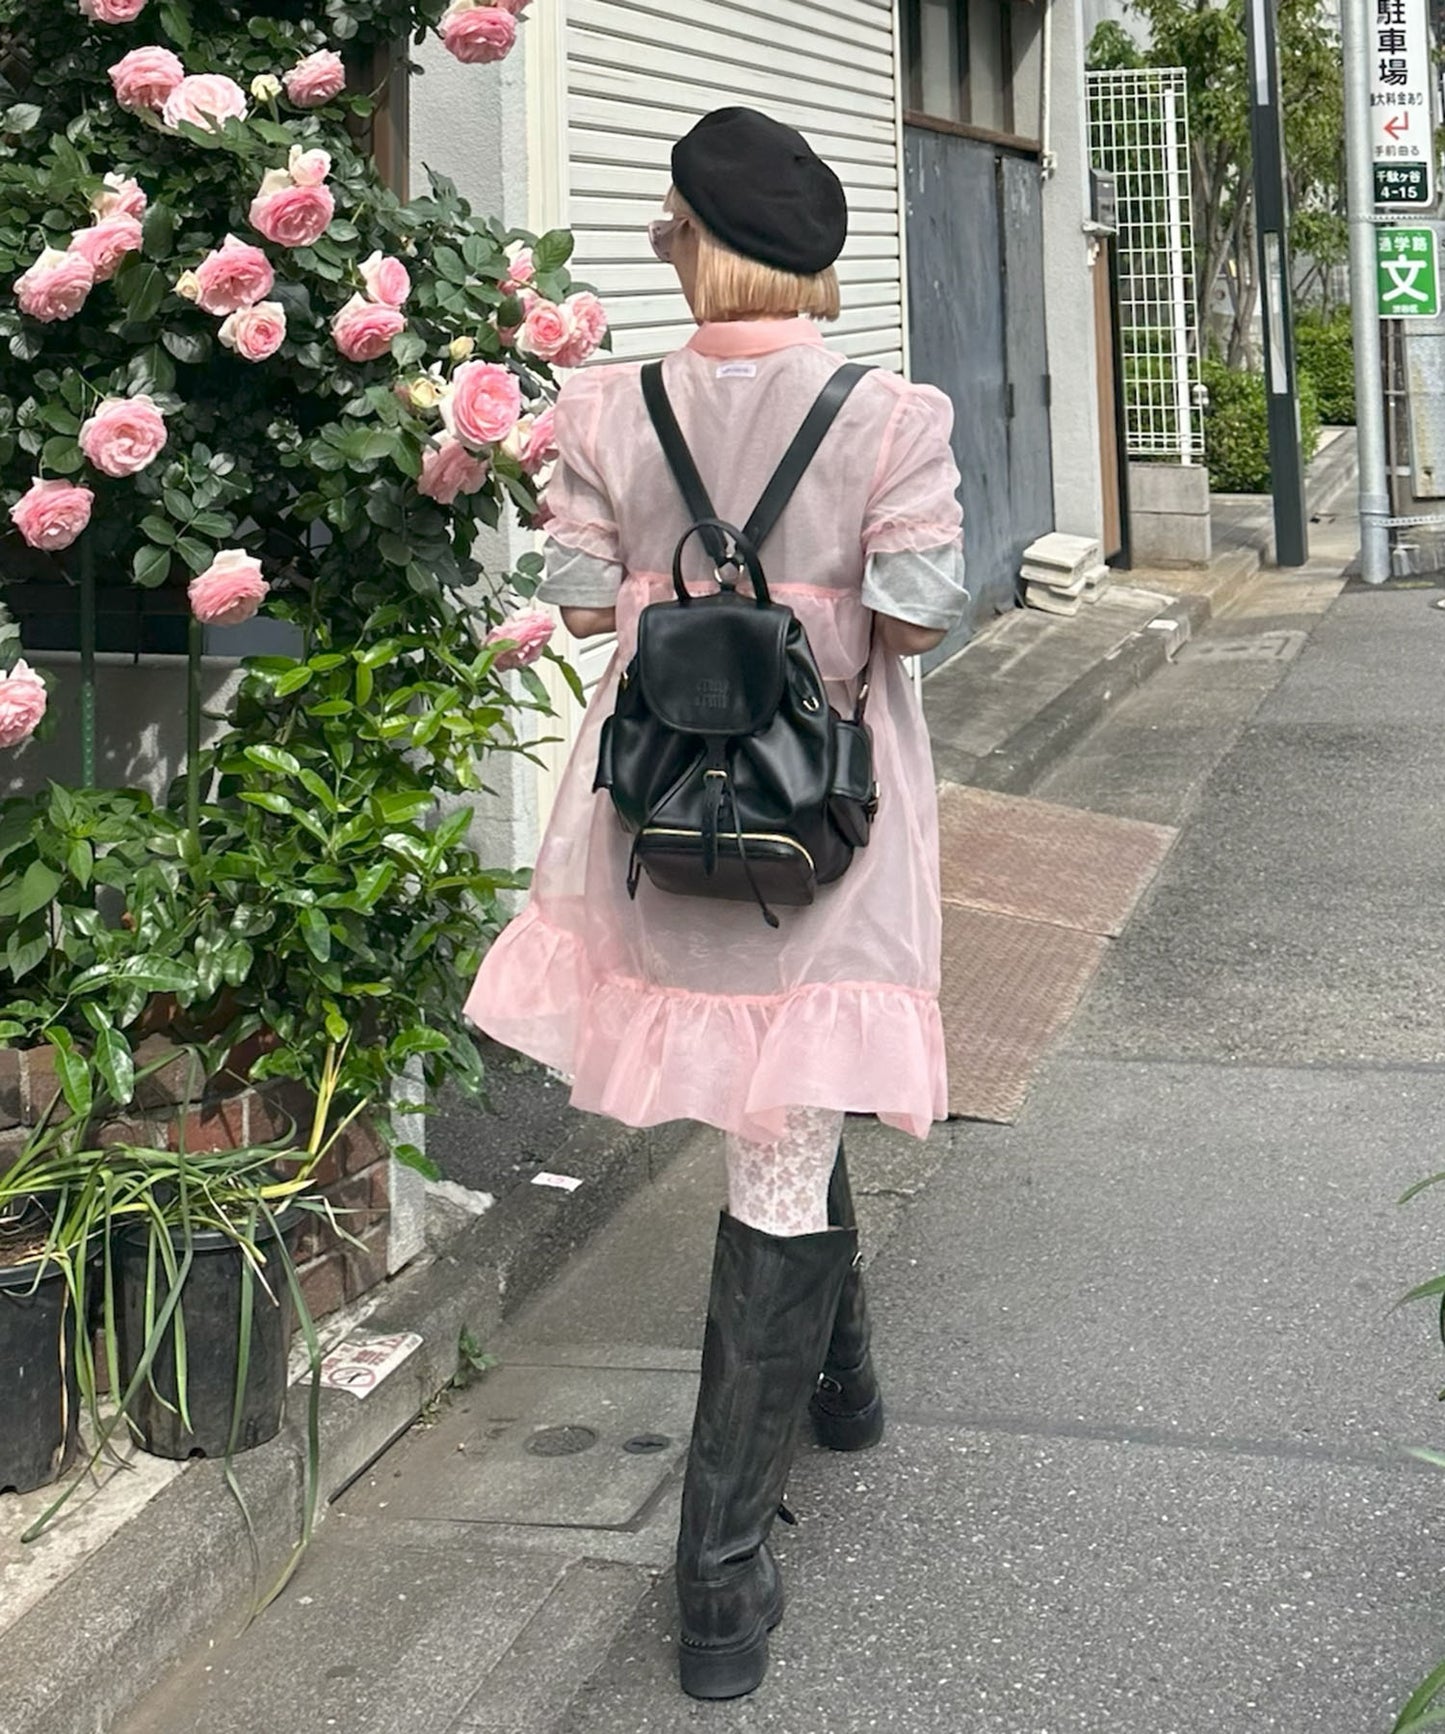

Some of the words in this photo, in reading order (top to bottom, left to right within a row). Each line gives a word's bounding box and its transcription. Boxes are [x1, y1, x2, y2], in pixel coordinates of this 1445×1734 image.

[1377, 0, 1408, 86] 駐車場
[1382, 186, 1418, 198] 4-15
[1380, 254, 1428, 302] 文
